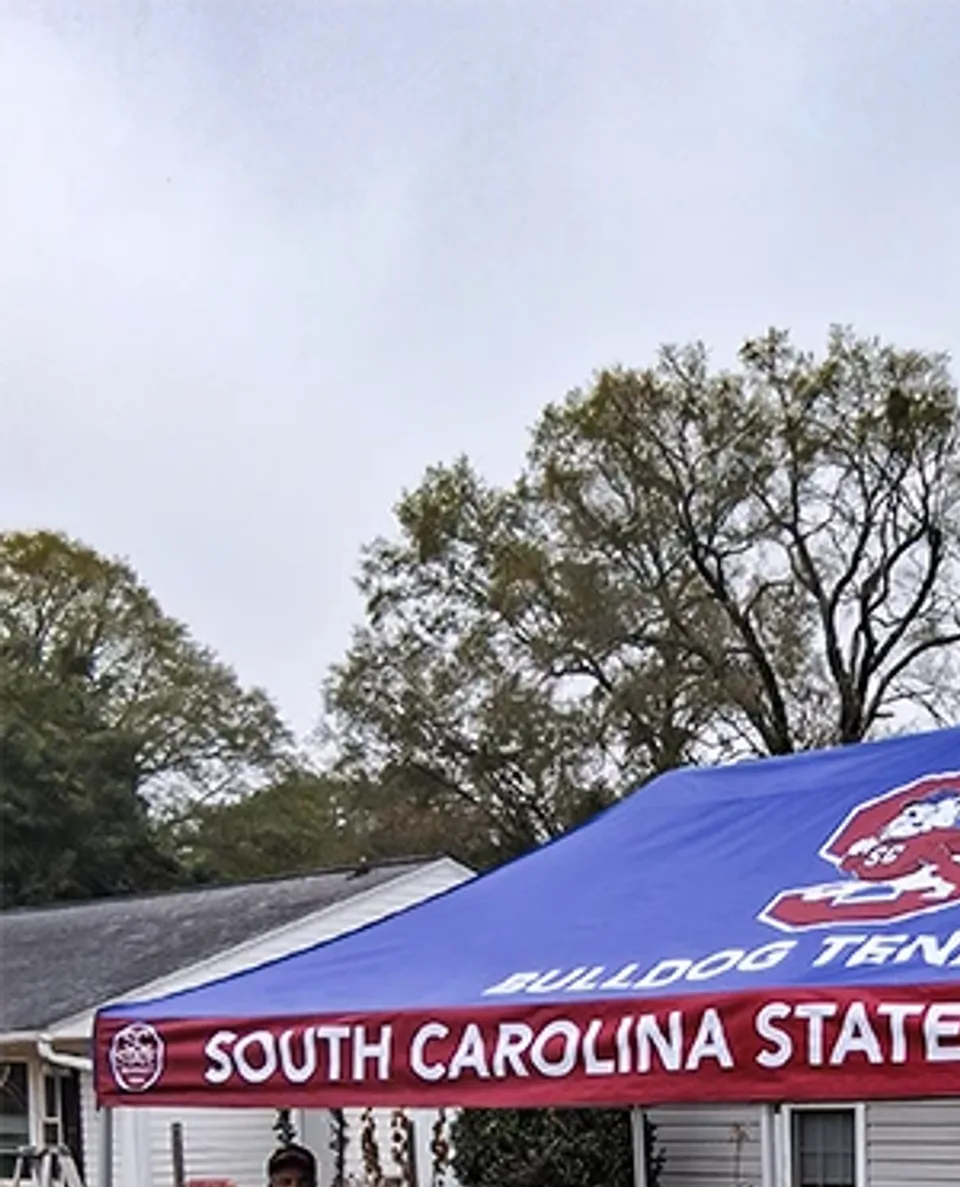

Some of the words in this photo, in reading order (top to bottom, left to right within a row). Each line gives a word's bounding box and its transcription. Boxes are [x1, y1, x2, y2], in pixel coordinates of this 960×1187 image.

[480, 939, 799, 996] BULLDOG
[205, 1025, 392, 1083] SOUTH
[411, 1008, 734, 1080] CAROLINA
